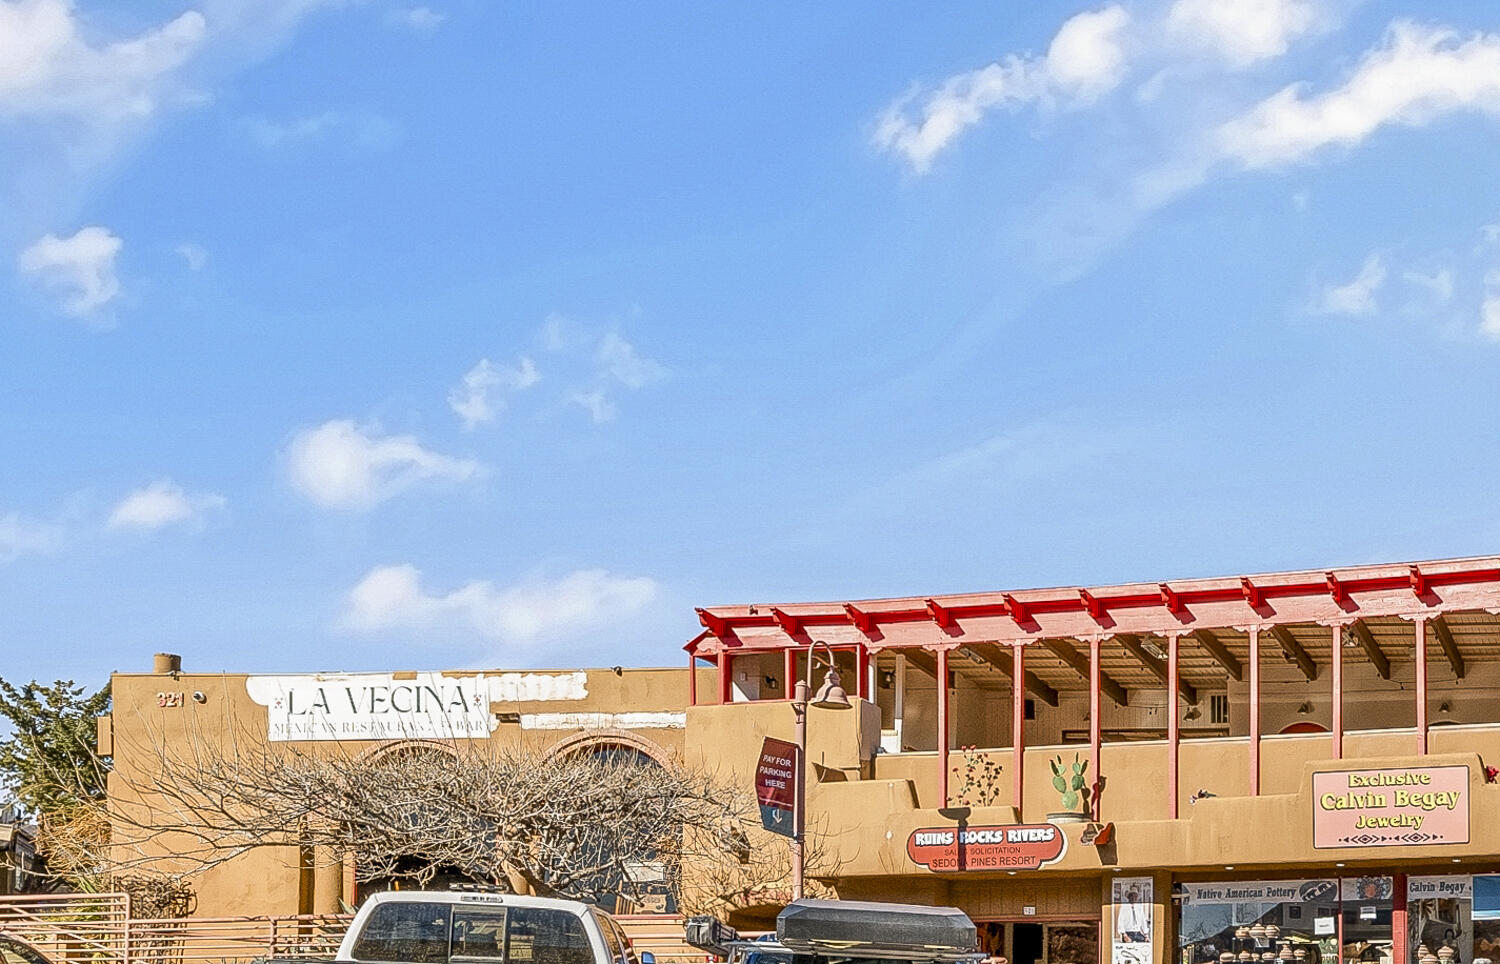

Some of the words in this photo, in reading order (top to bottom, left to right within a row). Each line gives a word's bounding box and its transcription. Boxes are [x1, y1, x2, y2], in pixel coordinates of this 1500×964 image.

[156, 691, 184, 708] 321
[287, 688, 331, 715] LA
[345, 685, 469, 714] VECINA
[456, 720, 483, 731] BAR
[763, 754, 776, 764] PAY
[776, 757, 792, 767] FOR
[760, 765, 792, 779] PARKING
[765, 779, 786, 789] HERE
[1348, 772, 1431, 787] Exclusive
[1320, 791, 1387, 810] Calvin
[1394, 789, 1461, 811] Begay
[1355, 813, 1424, 830] Jewelry
[915, 831, 954, 846] RUINS
[959, 829, 1003, 844] ROCKS
[1007, 827, 1055, 843] RIVERS
[970, 846, 1021, 856] SOLICITATION
[971, 856, 997, 867] PINES
[1000, 855, 1037, 866] RESORT
[1197, 888, 1222, 900] Native
[1225, 887, 1263, 899] American
[1266, 886, 1298, 899] Pottery
[1410, 882, 1435, 892] Calvin
[1439, 881, 1465, 894] Begay
